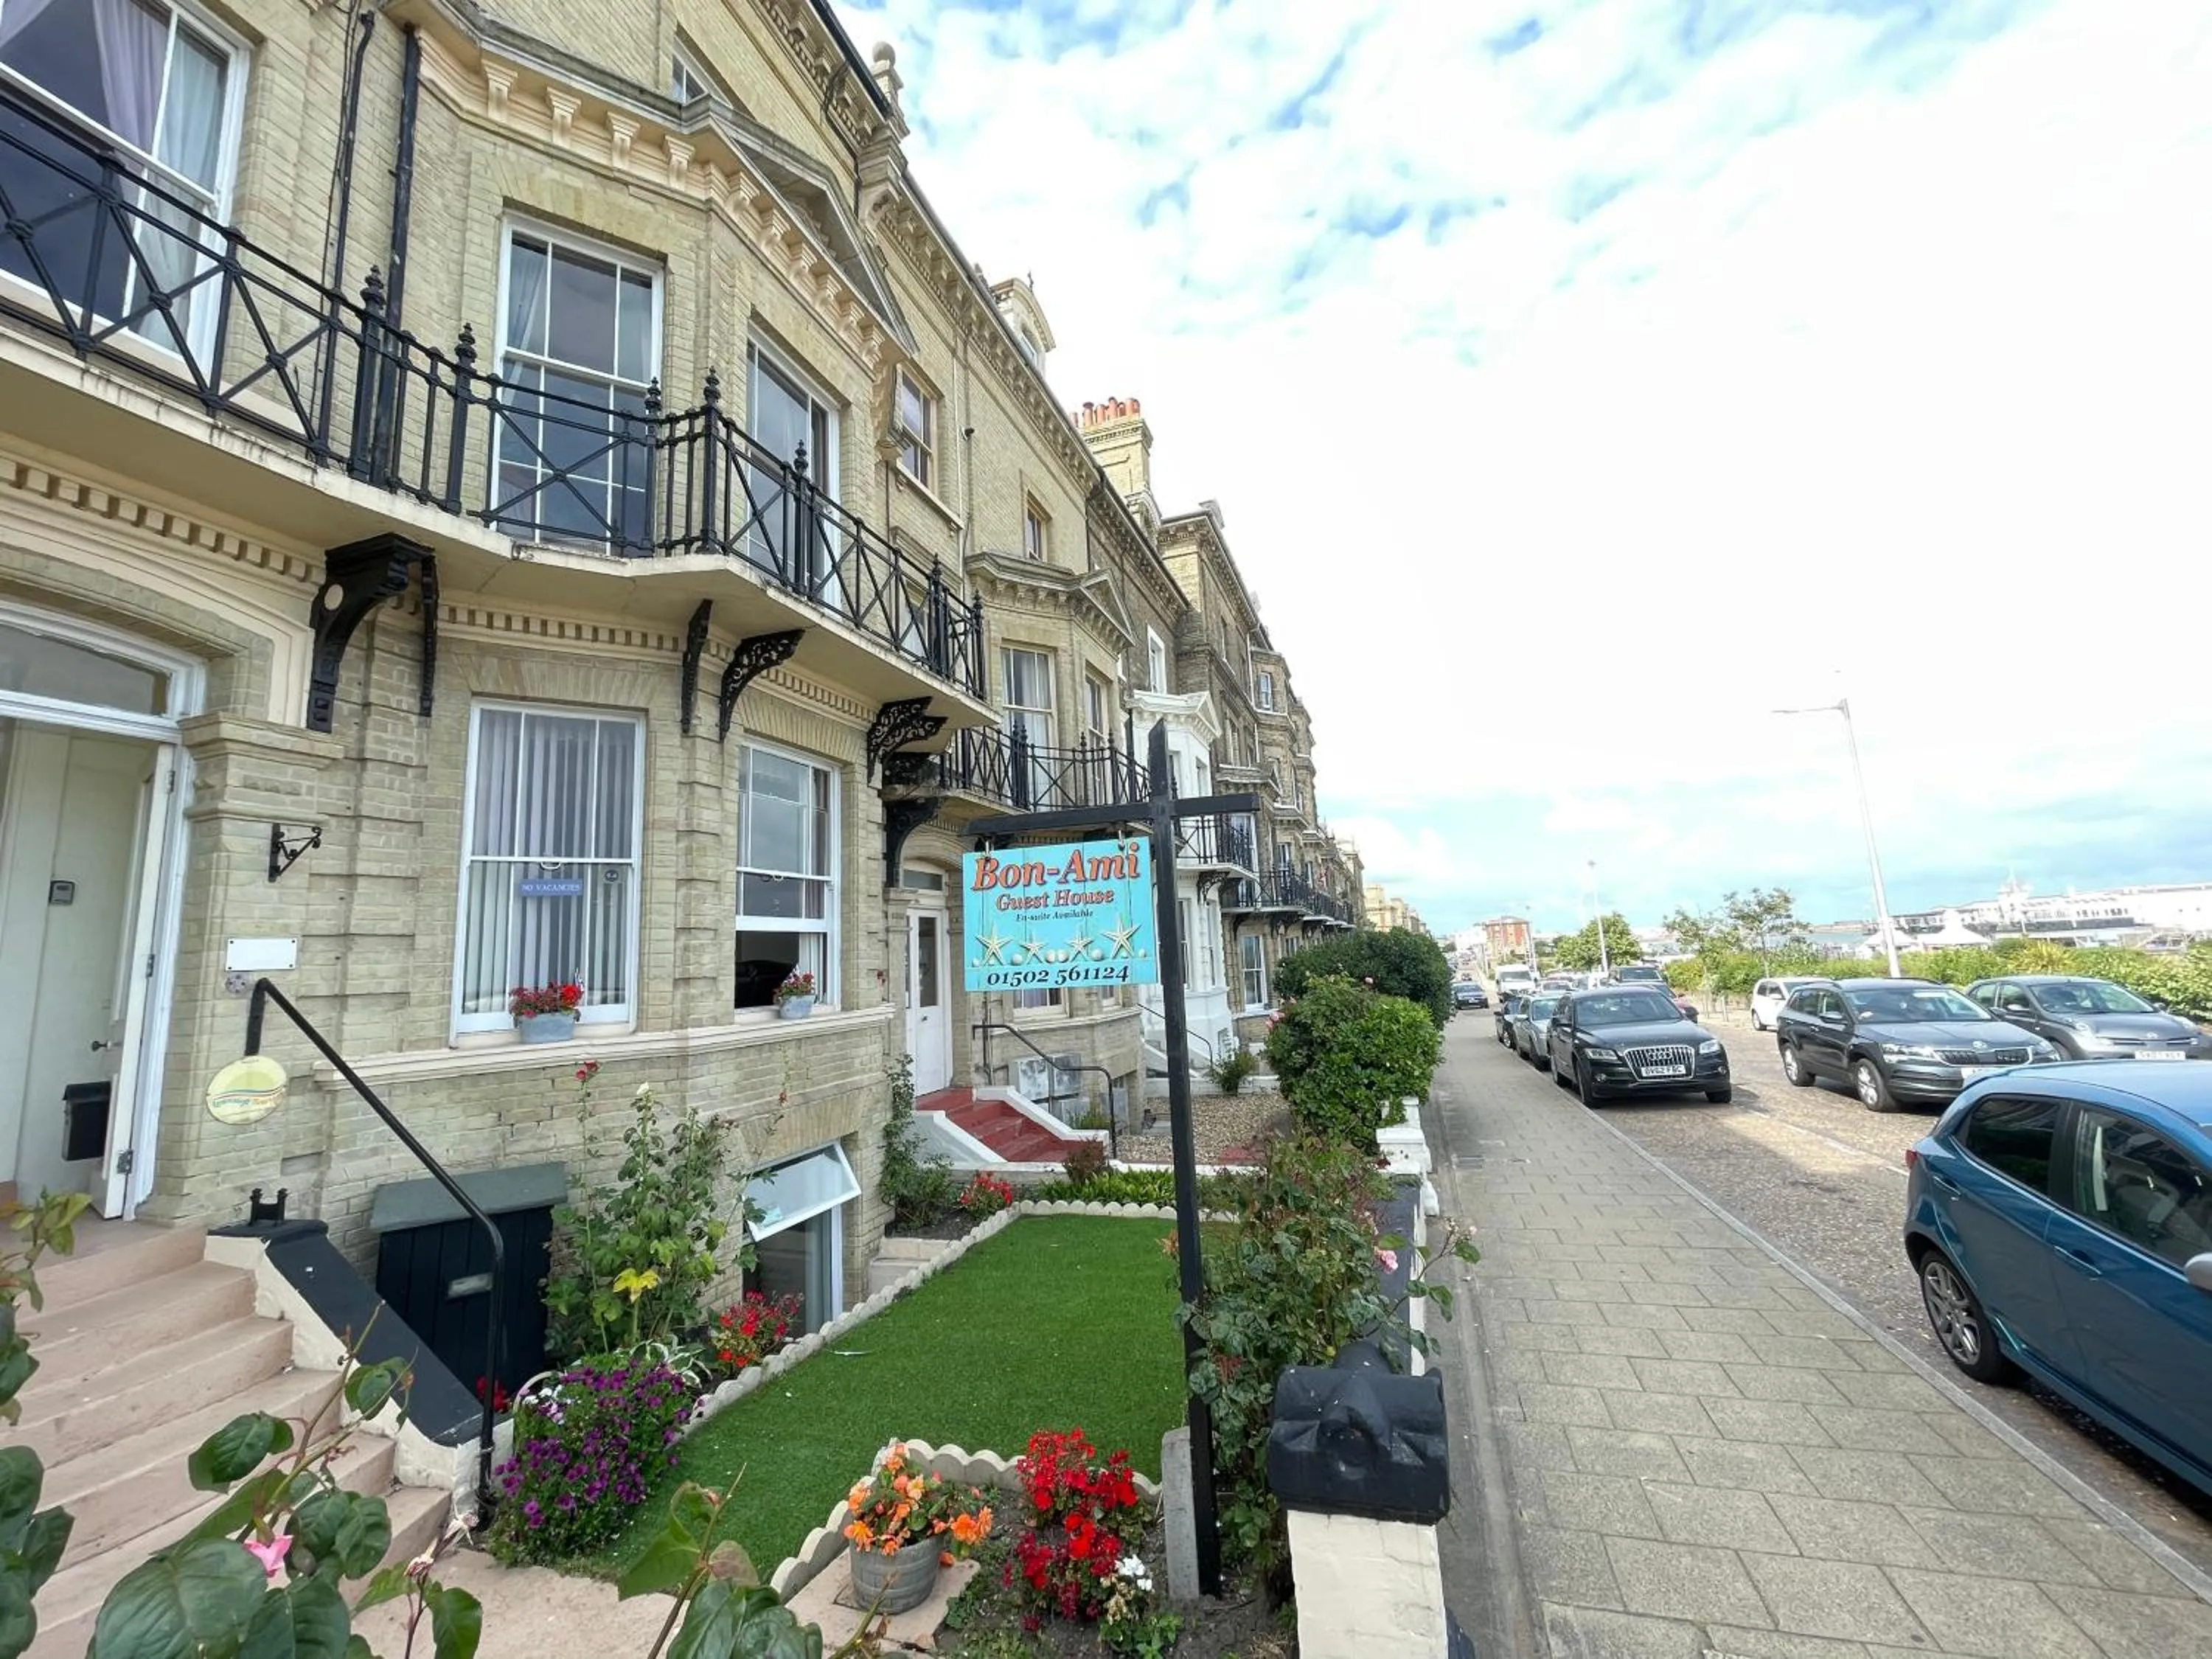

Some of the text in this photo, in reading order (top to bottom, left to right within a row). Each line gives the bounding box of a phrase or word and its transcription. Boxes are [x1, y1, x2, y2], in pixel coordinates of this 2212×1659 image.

[971, 842, 1141, 891] Bon-Ami
[521, 883, 581, 892] NO VACANCIES
[996, 888, 1115, 911] Guest House
[1052, 908, 1093, 919] Available
[987, 965, 1130, 987] 01502 561124
